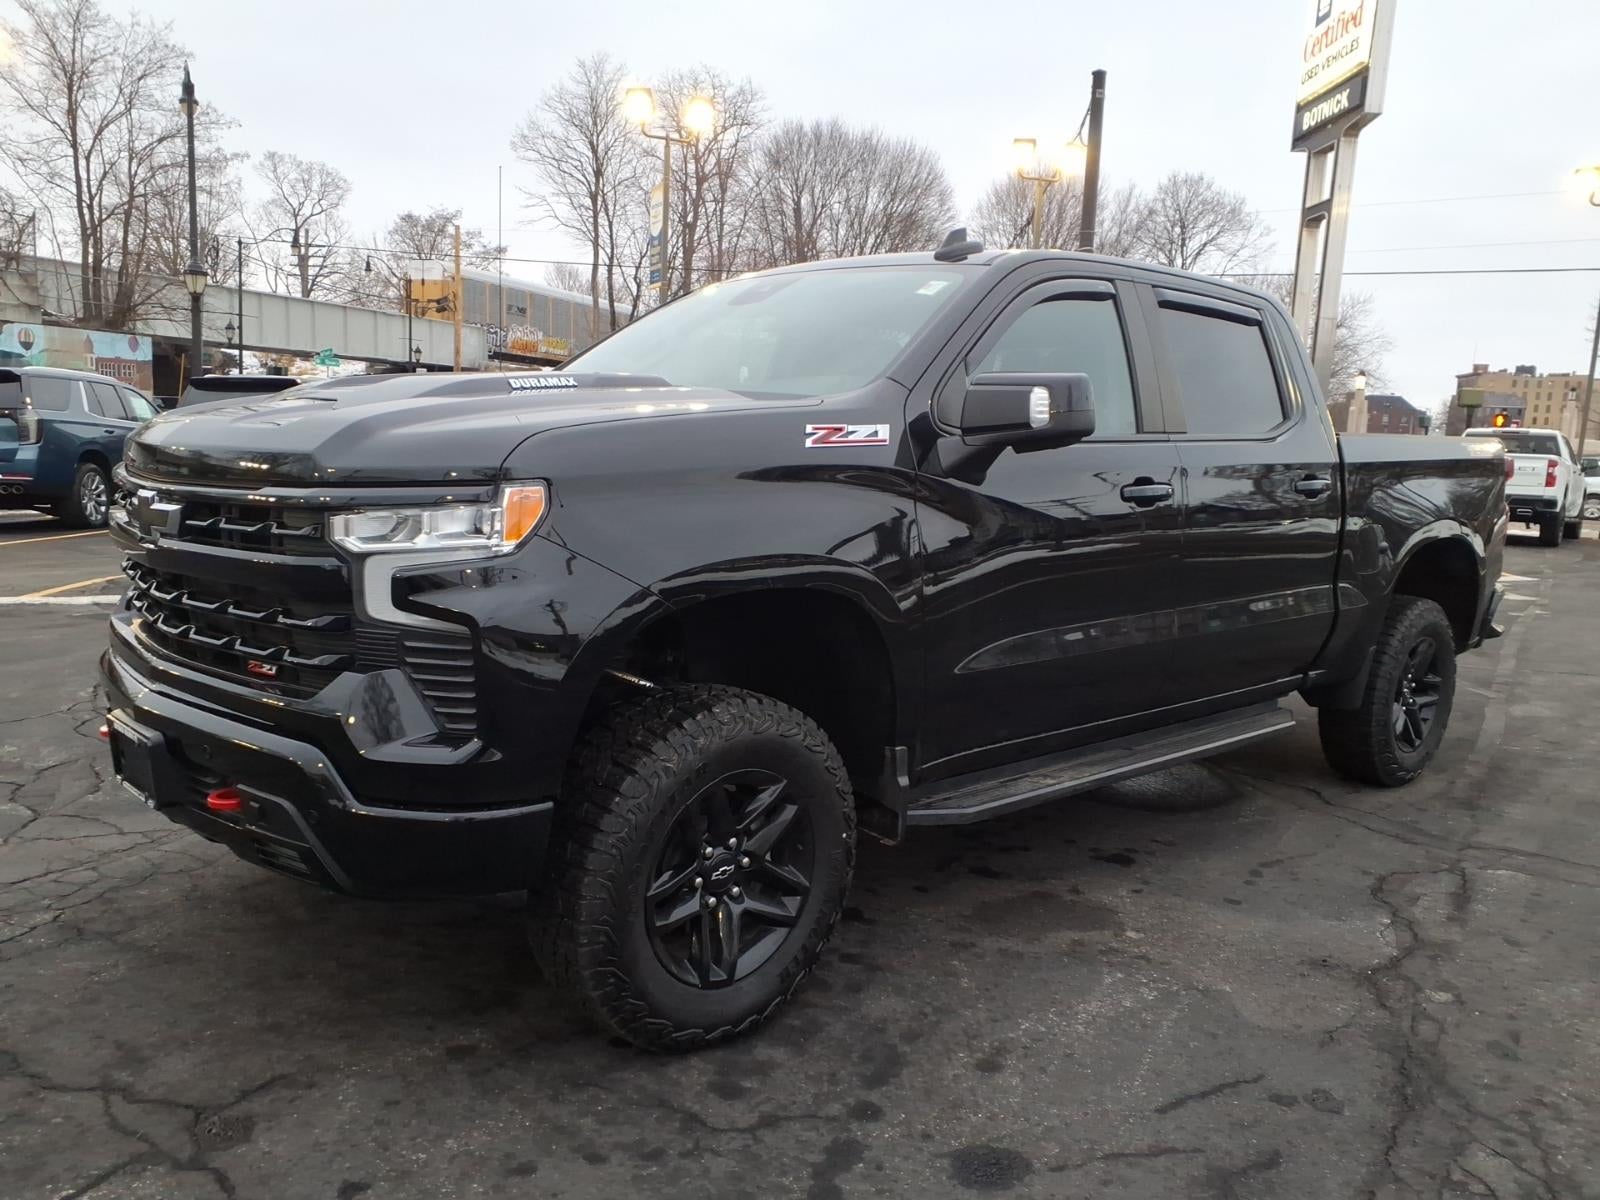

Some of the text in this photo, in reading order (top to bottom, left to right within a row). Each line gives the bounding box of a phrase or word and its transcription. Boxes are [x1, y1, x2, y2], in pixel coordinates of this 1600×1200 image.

[1303, 1, 1364, 63] Certified
[1301, 37, 1360, 85] USED VEHICLES
[1302, 88, 1350, 131] BOTNICK
[508, 376, 579, 390] DURAMAX
[805, 424, 890, 448] Z71
[247, 660, 279, 678] Z71
